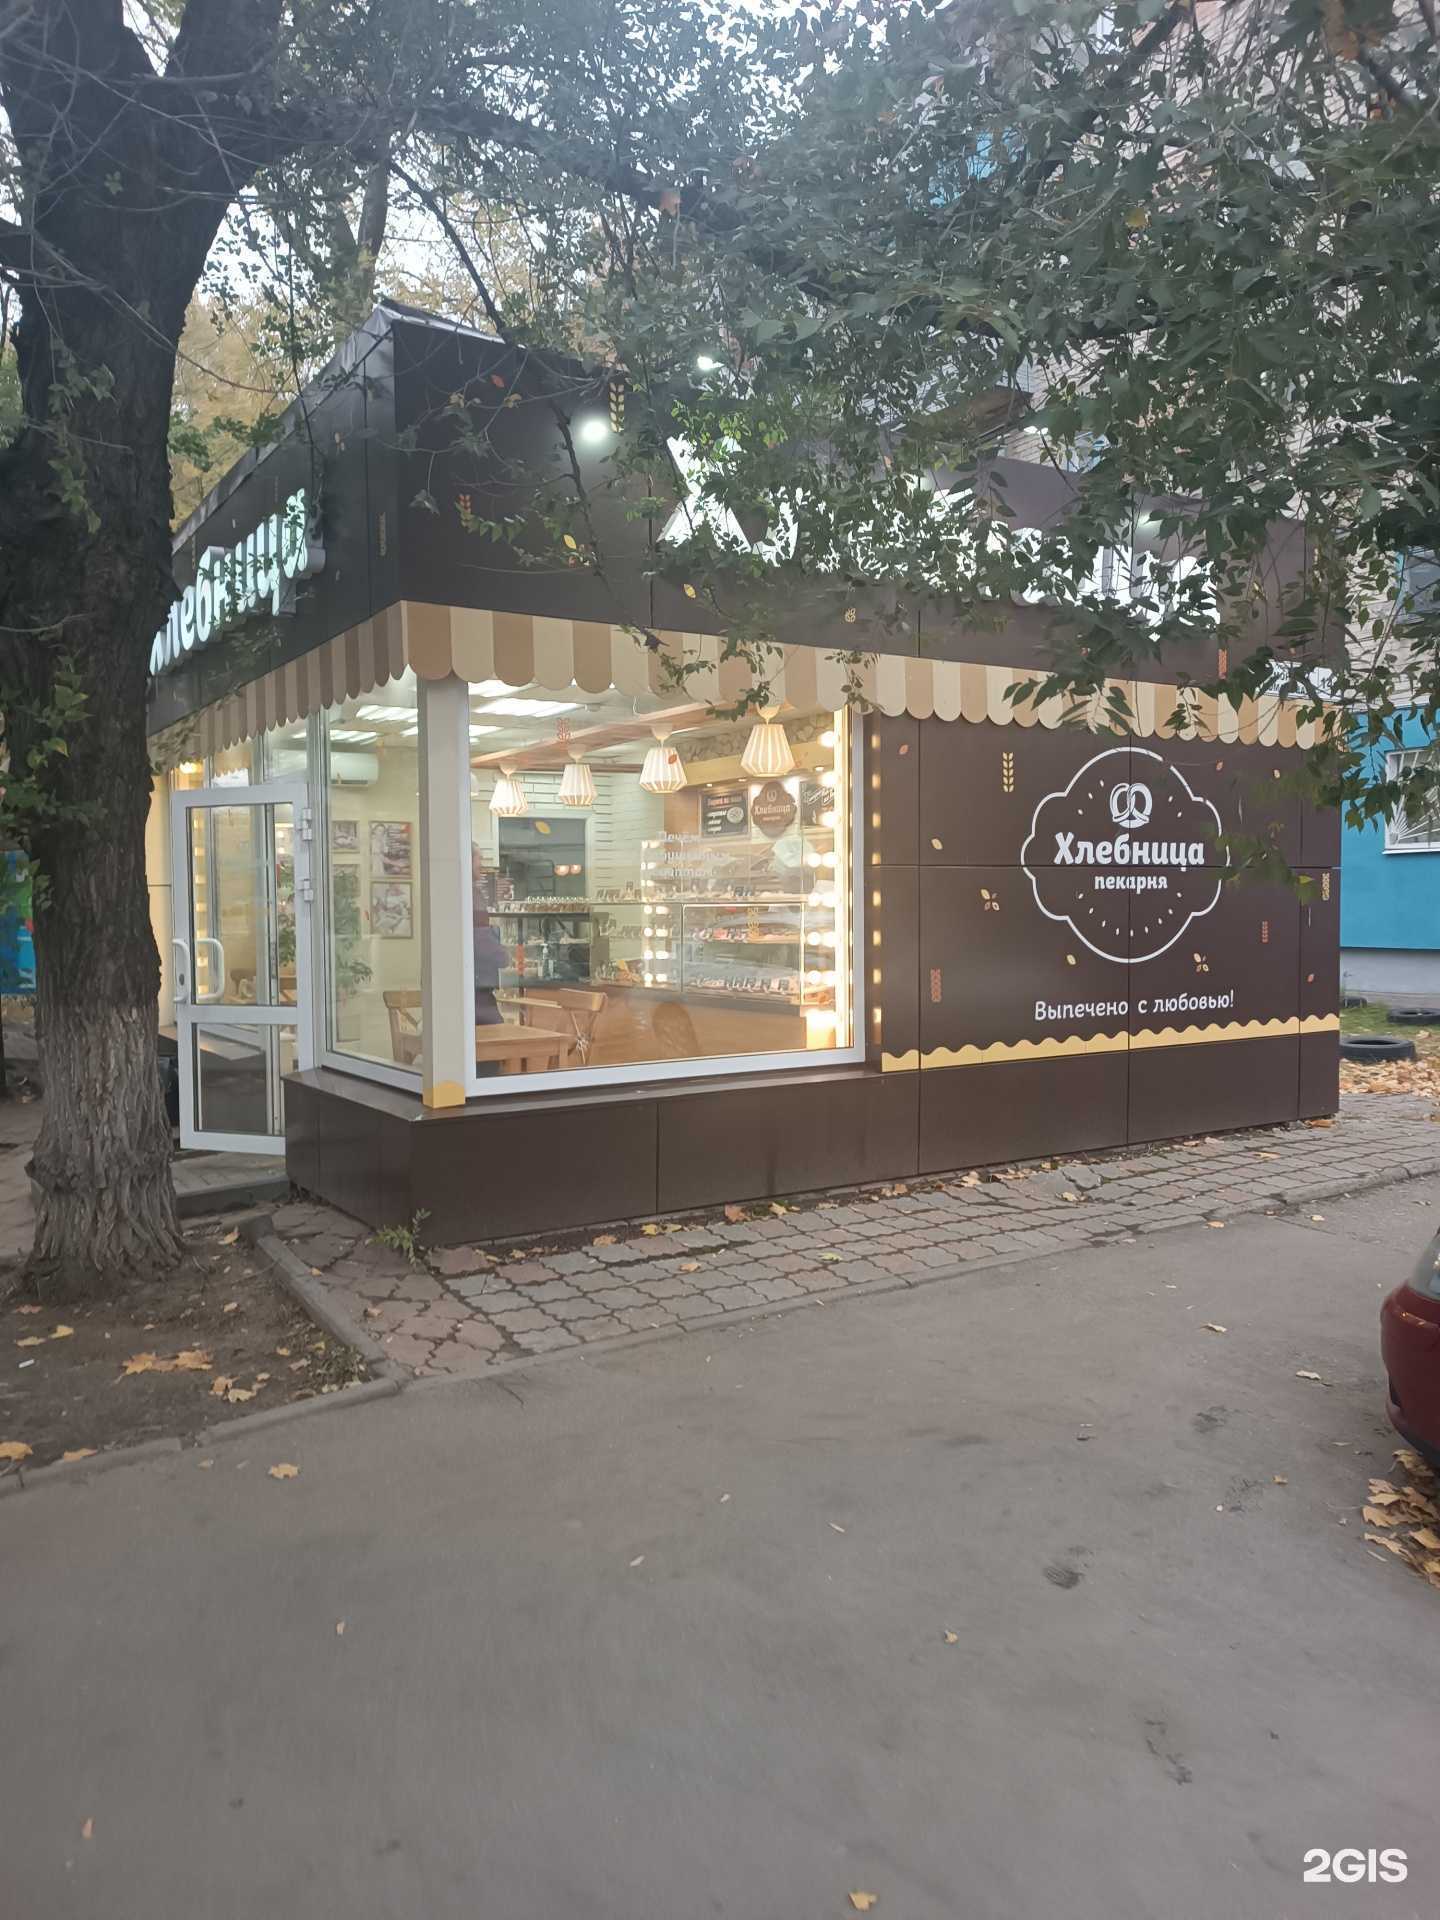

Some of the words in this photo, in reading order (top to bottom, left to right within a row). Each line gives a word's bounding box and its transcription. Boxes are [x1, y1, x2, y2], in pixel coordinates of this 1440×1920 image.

[1053, 831, 1205, 872] Хлебница
[1094, 874, 1168, 894] пекарня
[1034, 999, 1129, 1021] Выпечено
[1137, 1000, 1148, 1014] с
[1152, 989, 1234, 1014] любовью!
